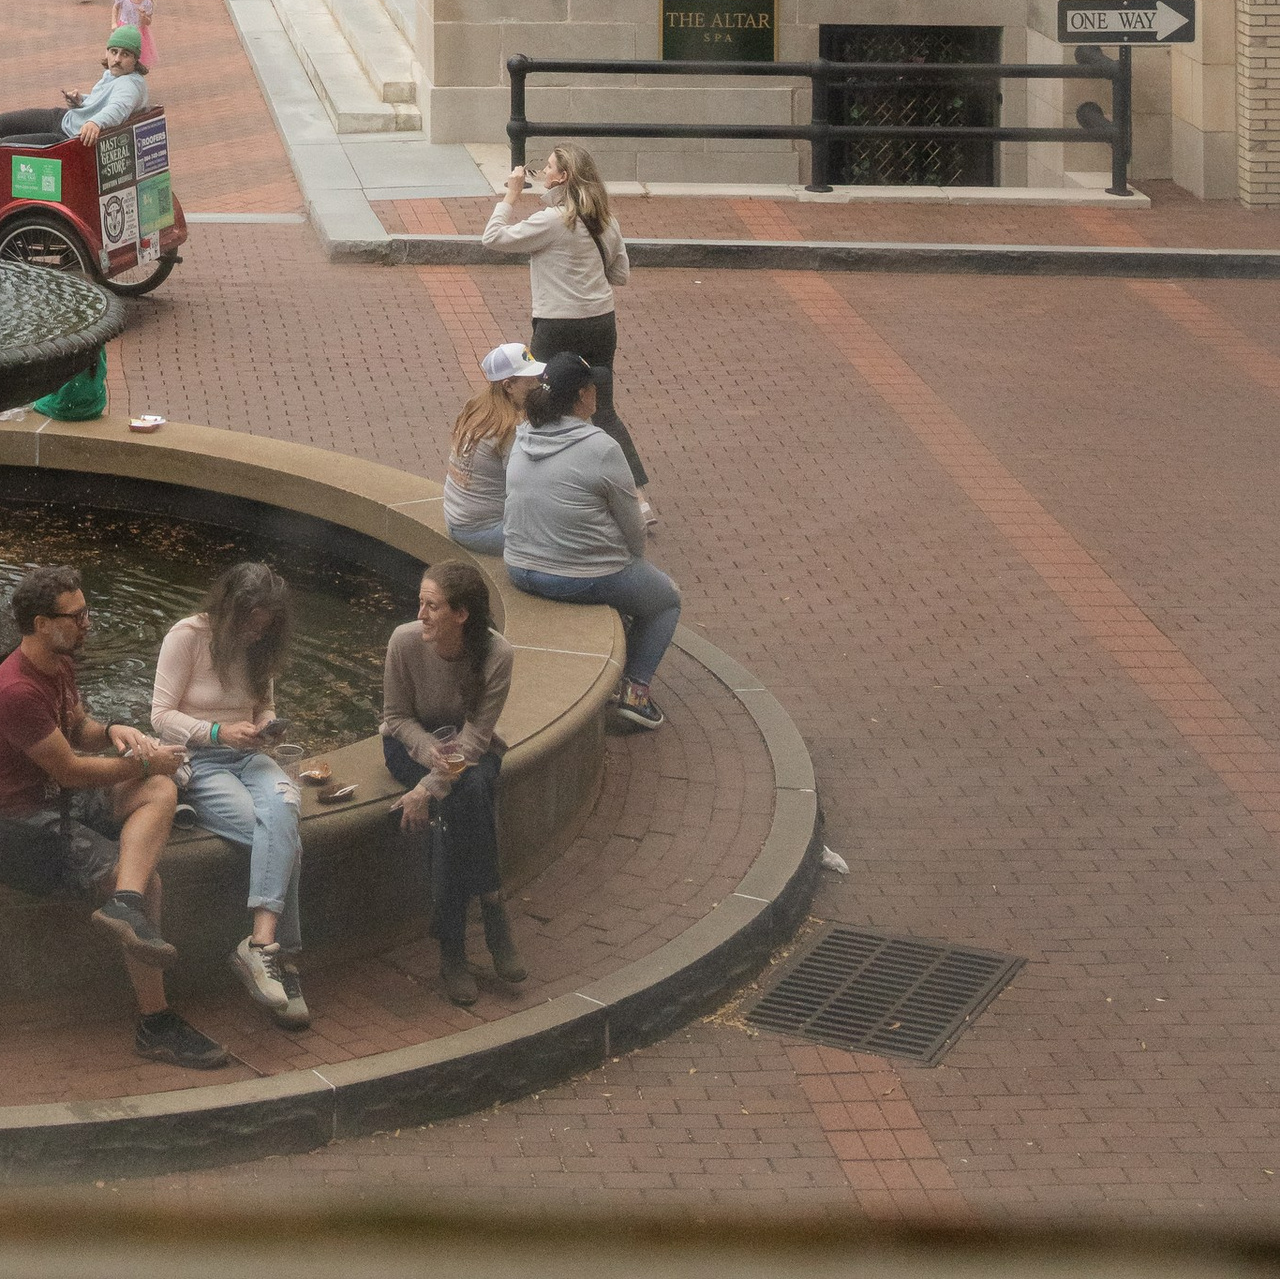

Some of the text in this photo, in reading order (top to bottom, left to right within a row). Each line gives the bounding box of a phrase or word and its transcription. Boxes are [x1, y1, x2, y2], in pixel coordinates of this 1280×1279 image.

[666, 12, 771, 29] THE ALTAR
[1071, 12, 1157, 30] ONE WAY
[704, 33, 733, 42] SPA
[100, 136, 118, 152] MAST
[101, 145, 130, 165] GENERAL
[107, 158, 127, 176] STORE
